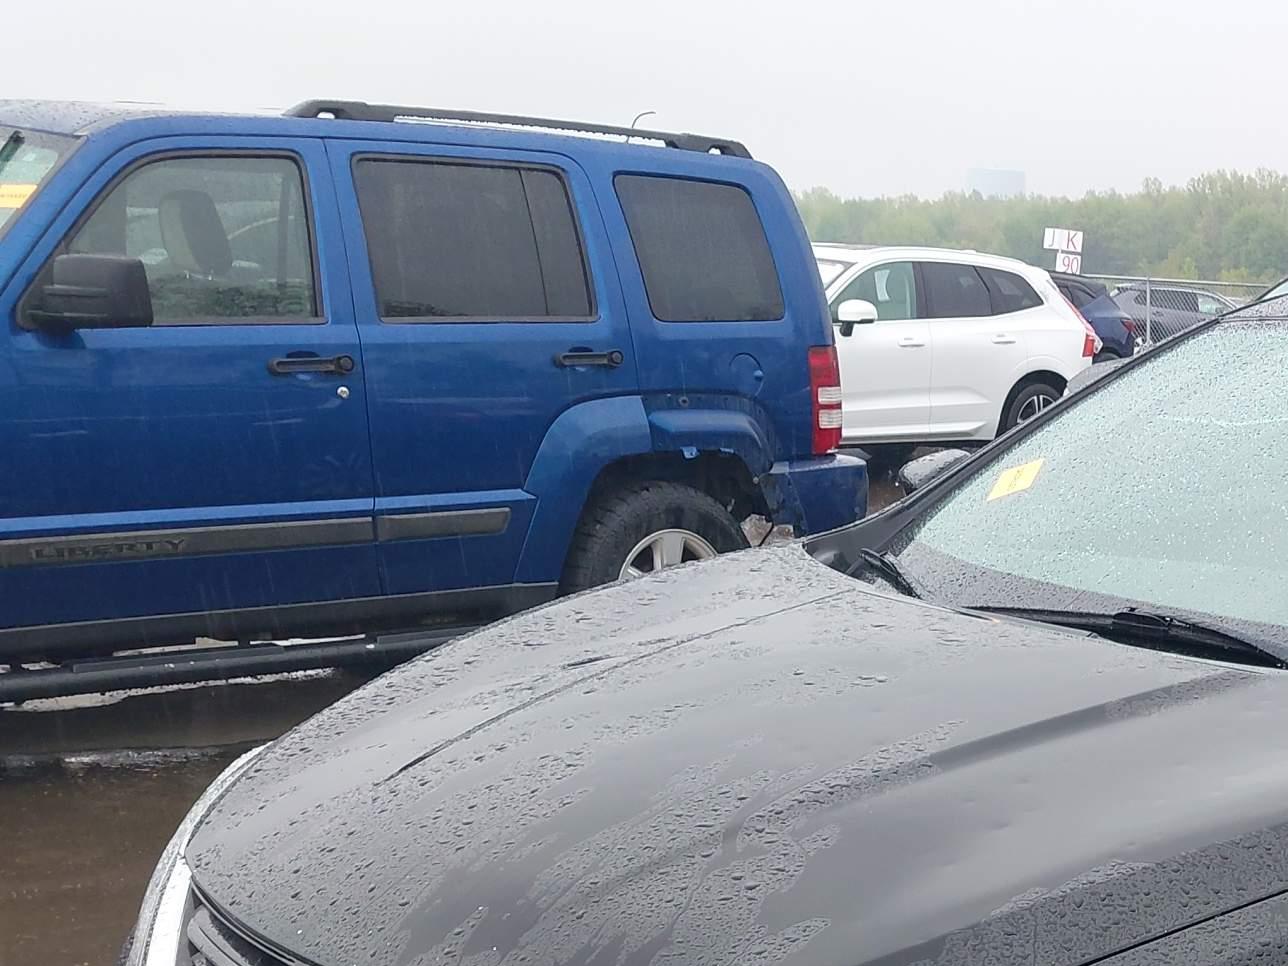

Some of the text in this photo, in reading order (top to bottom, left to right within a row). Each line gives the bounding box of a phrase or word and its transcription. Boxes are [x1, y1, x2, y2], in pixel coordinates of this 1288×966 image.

[1048, 229, 1078, 251] J K
[1062, 255, 1080, 275] 90
[31, 537, 185, 561] LIBERTY
